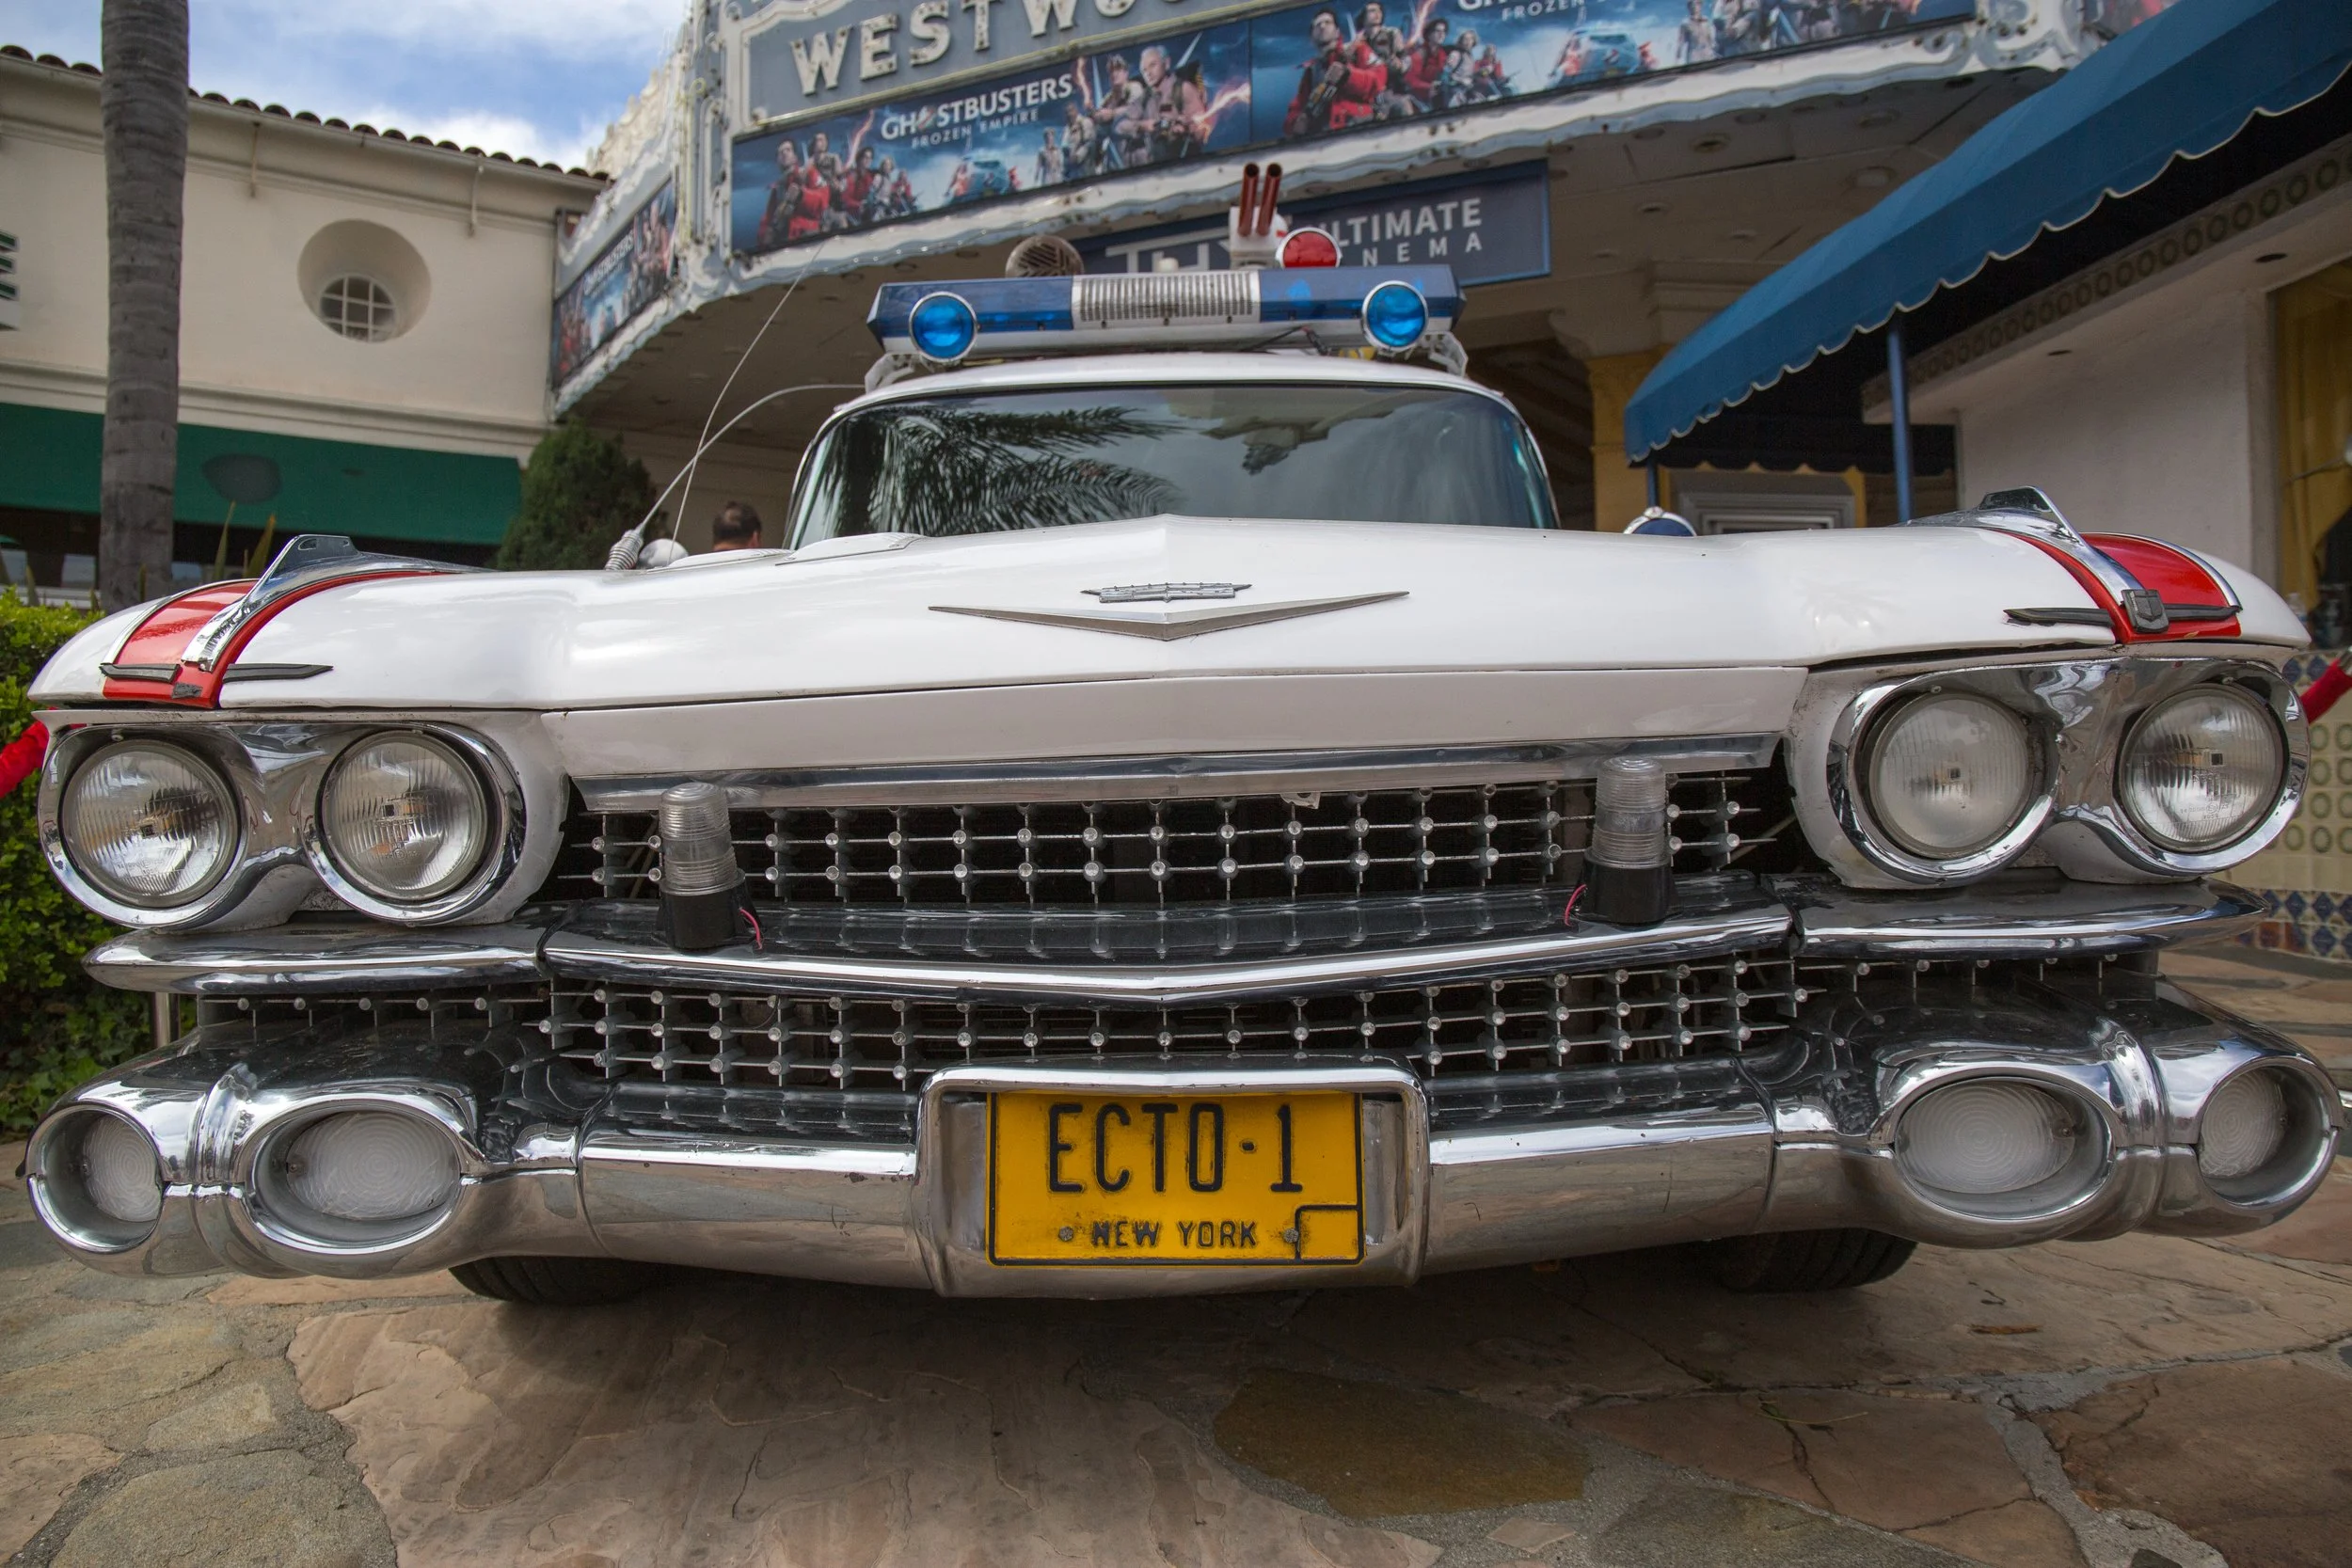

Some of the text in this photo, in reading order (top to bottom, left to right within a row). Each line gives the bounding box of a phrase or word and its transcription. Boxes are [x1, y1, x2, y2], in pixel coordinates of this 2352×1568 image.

[911, 107, 1039, 150] FROZEN EMPIRE
[1320, 198, 1483, 247] LTIMATE
[1092, 1221, 1257, 1247] NEW YORK
